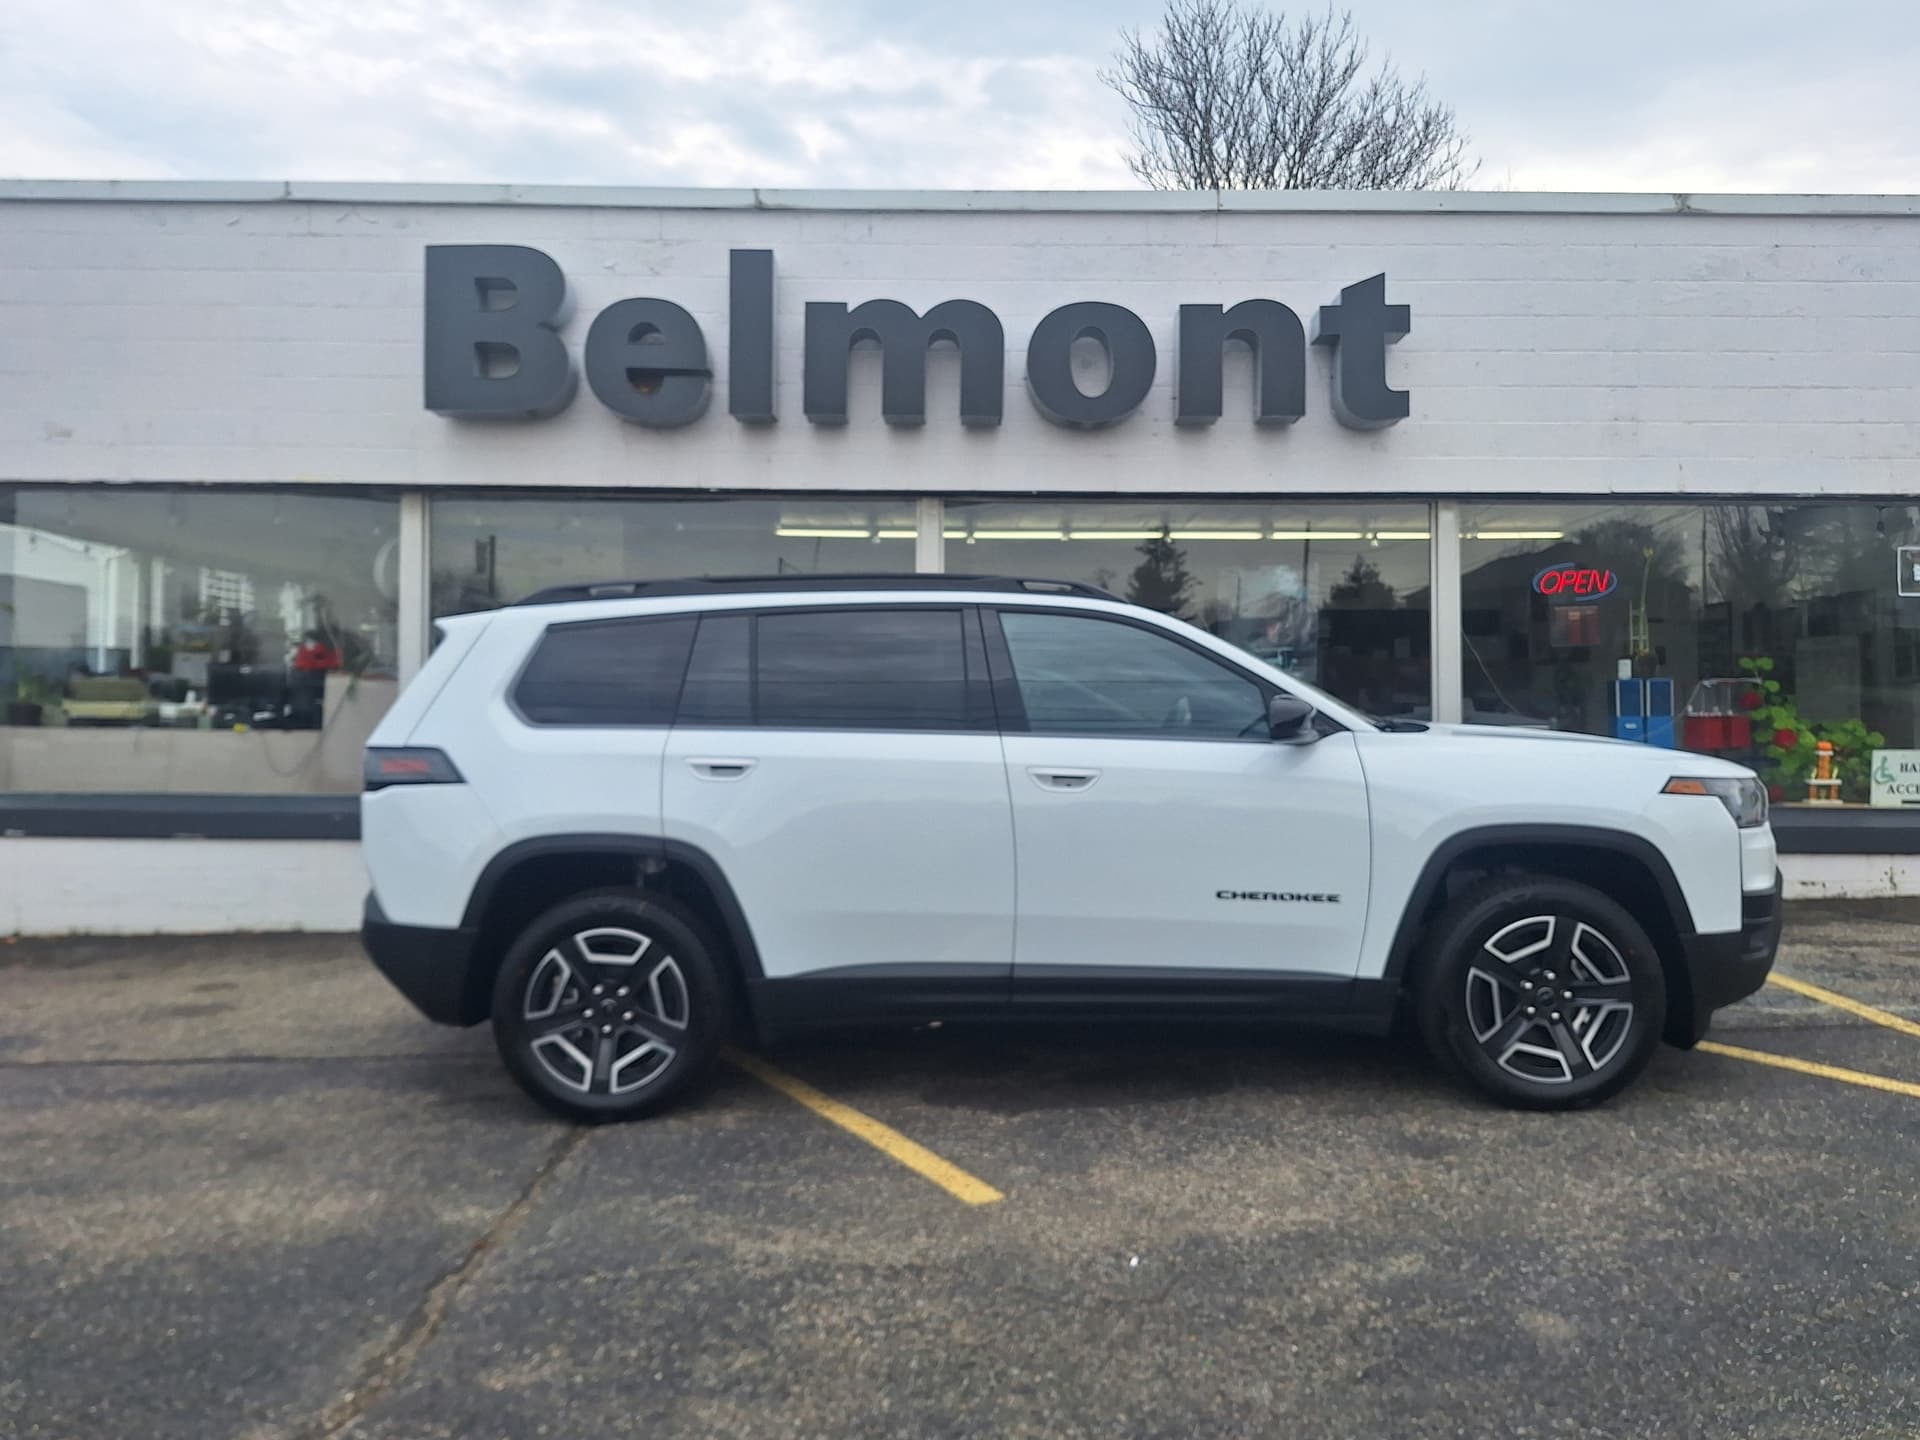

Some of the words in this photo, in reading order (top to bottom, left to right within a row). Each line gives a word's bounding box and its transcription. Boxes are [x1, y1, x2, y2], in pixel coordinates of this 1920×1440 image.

[424, 244, 1411, 428] Belmont
[1540, 569, 1611, 595] OPEN
[1900, 762, 1920, 773] HA
[1216, 889, 1341, 903] CHEROKEE
